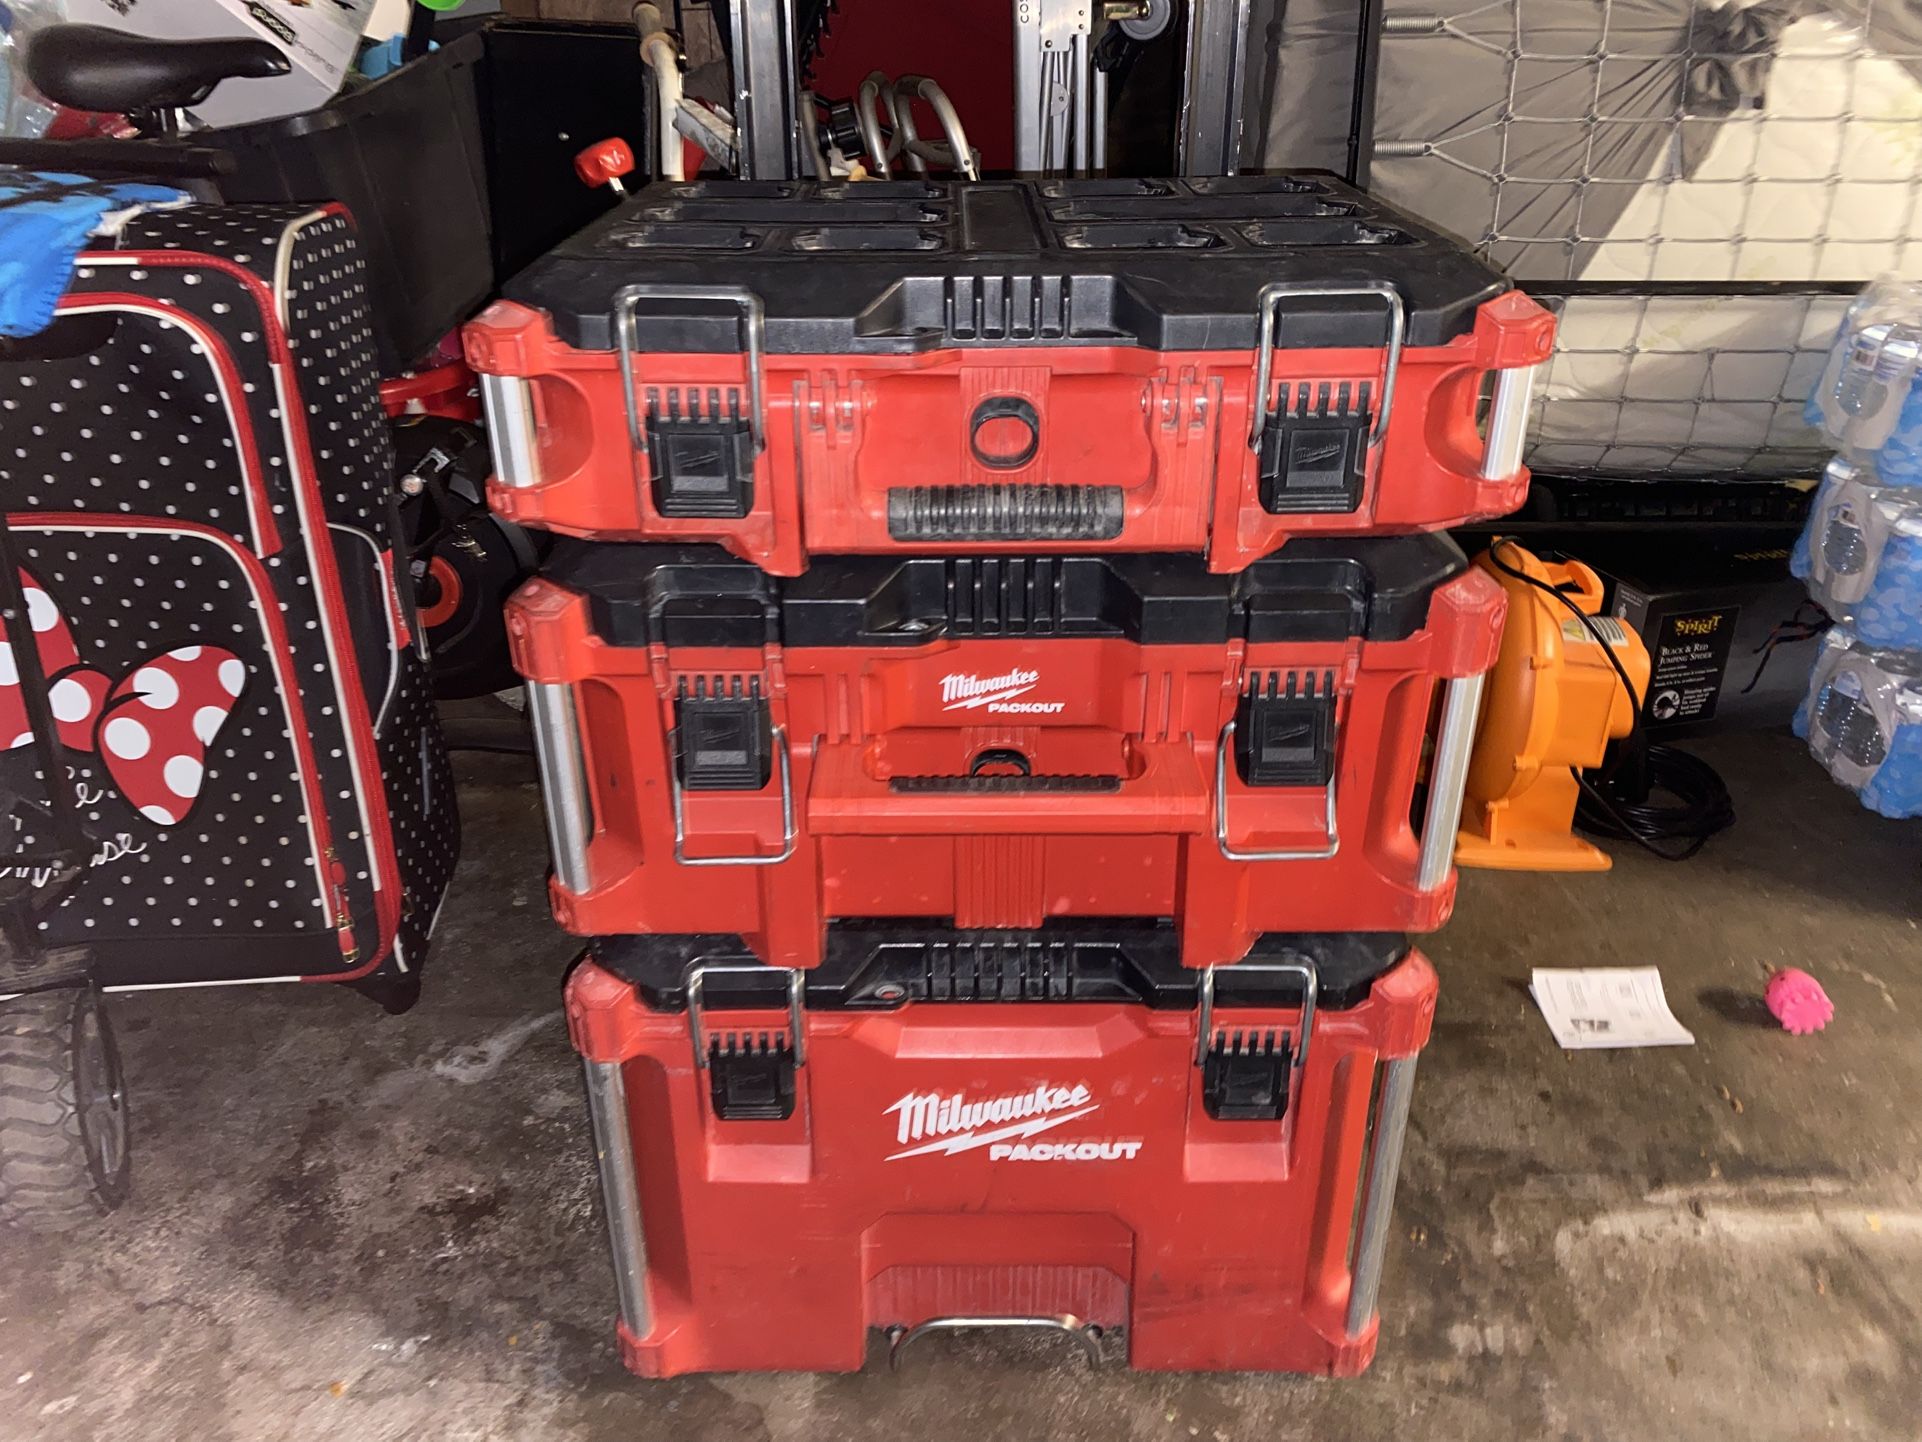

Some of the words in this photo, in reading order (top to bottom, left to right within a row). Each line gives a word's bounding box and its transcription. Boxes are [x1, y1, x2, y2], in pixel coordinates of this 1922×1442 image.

[1020, 0, 1029, 23] CO
[1675, 614, 1722, 635] SPIRIT
[1659, 655, 1687, 667] JUMPING
[1690, 651, 1712, 660] SPIDER
[1662, 646, 1683, 656] BLACK
[1685, 645, 1691, 653] &
[939, 668, 1040, 703] Milwaukee
[988, 702, 1065, 713] PACKOUT
[882, 1083, 1092, 1145] Milwaukee
[989, 1142, 1142, 1161] PACKOUT
